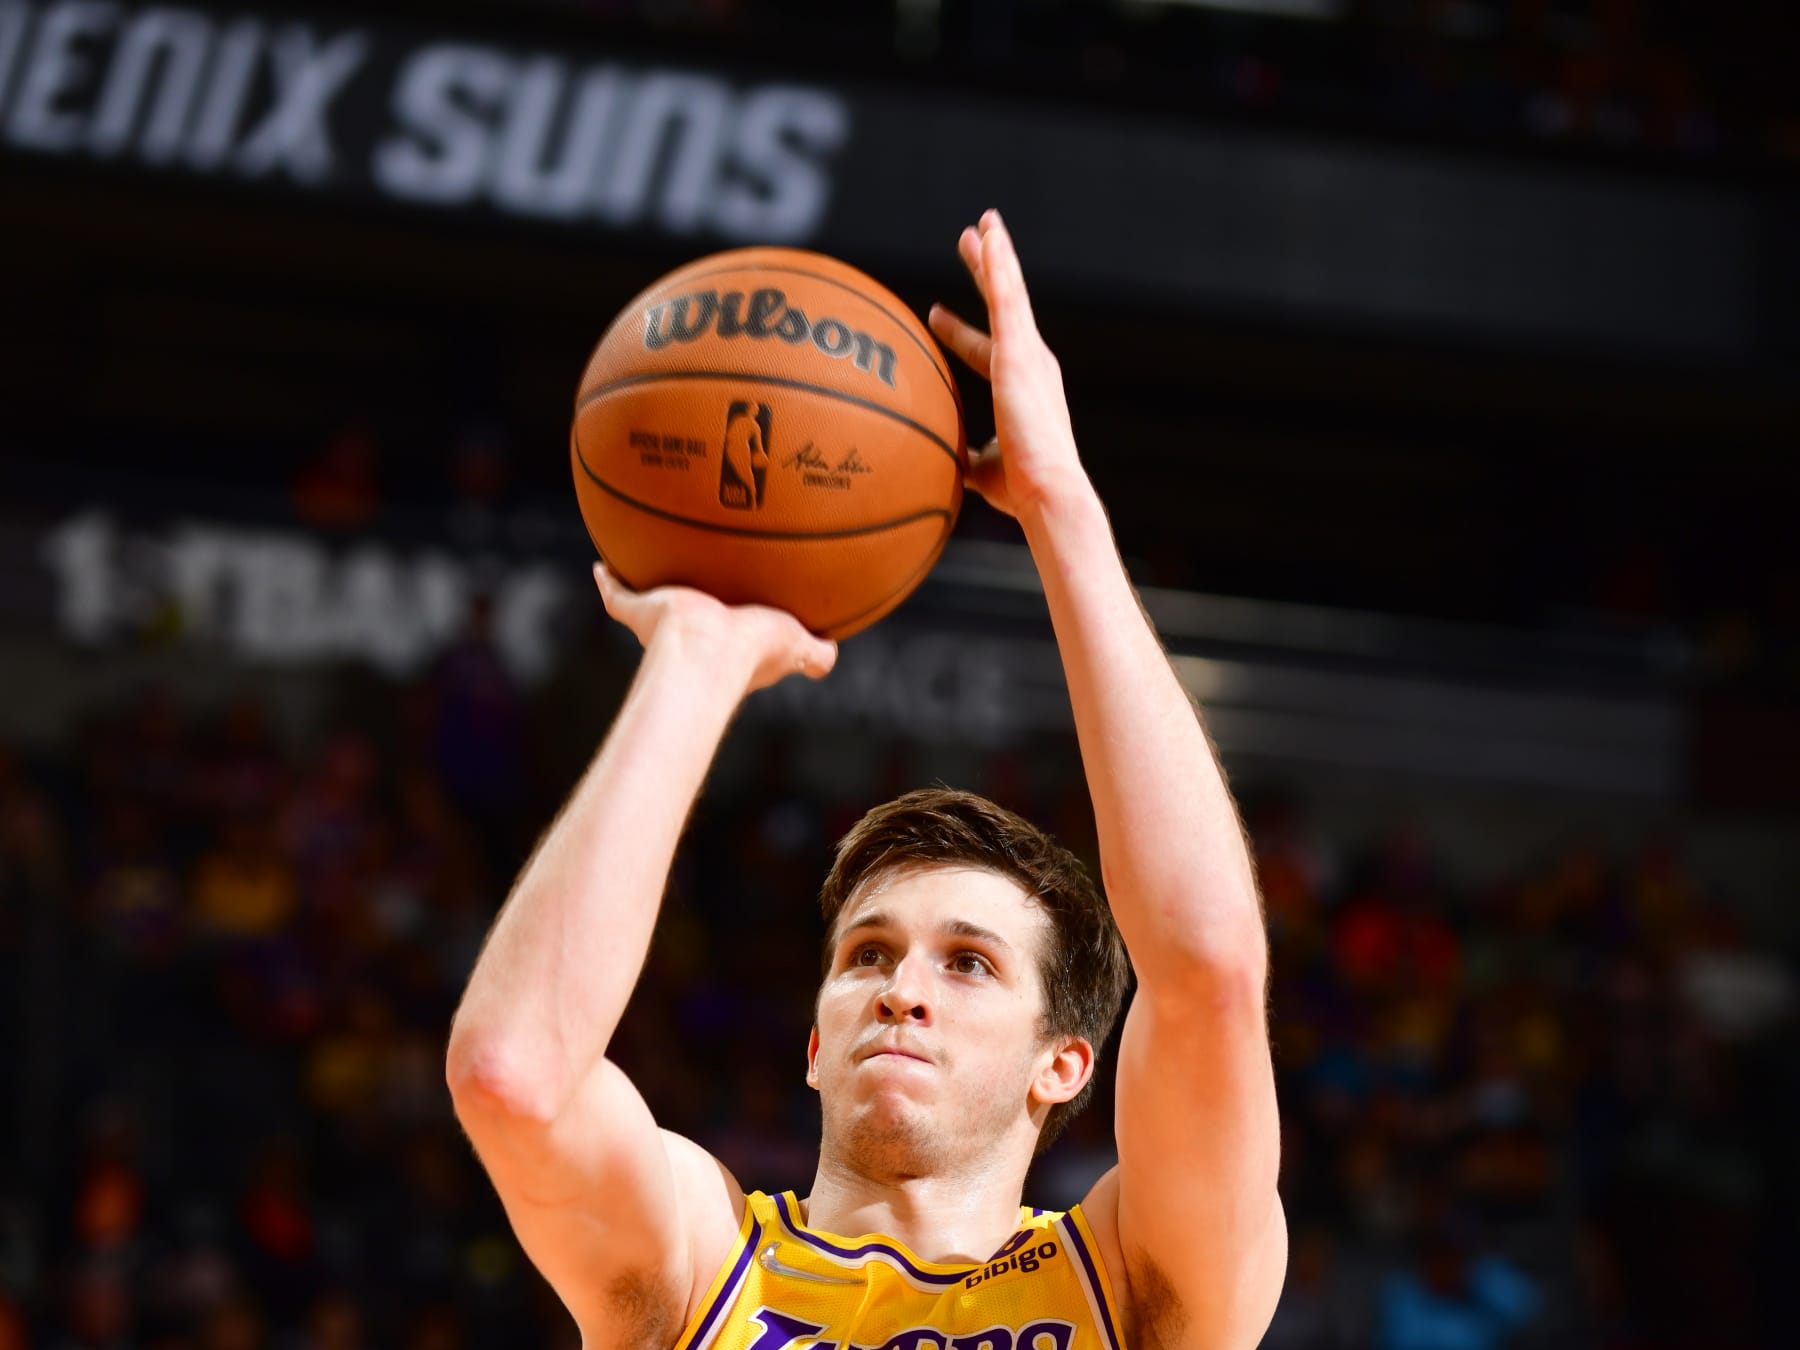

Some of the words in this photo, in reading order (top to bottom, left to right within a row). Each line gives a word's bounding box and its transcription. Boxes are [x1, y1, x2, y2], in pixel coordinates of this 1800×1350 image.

[374, 42, 851, 244] SUNS
[643, 287, 898, 390] Wilson
[965, 1241, 1058, 1290] bibigo
